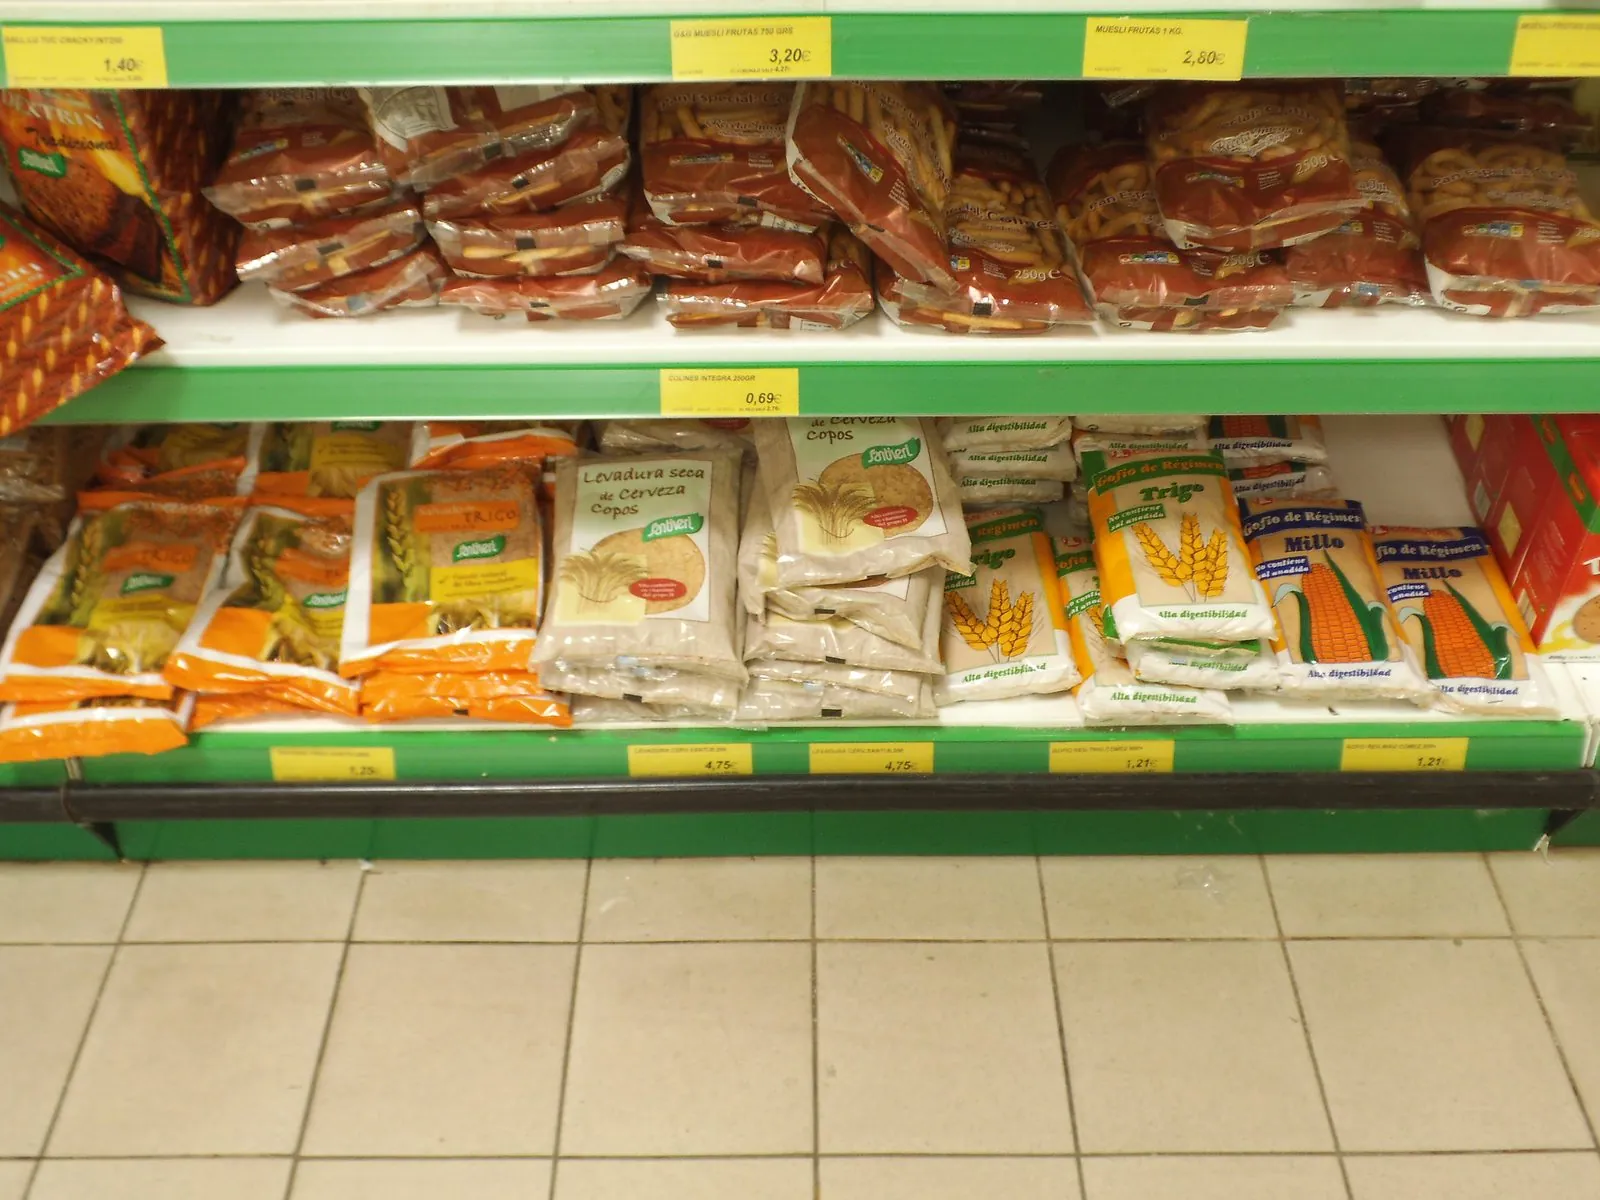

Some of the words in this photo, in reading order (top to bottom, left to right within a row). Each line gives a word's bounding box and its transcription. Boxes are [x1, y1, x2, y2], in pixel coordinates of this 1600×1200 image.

[693, 28, 725, 37] MUESLI
[726, 27, 758, 36] FRUTAS
[1095, 25, 1126, 34] MUESLI
[1127, 26, 1161, 35] FRUTAS
[1294, 155, 1329, 176] 250g
[1221, 255, 1255, 268] 250g
[1013, 269, 1047, 281] 250g
[701, 374, 732, 382] INTEGRA
[966, 425, 985, 434] Alta
[986, 421, 1048, 433] digestibilidad
[1107, 442, 1127, 450] Alta
[988, 454, 1049, 463] digestibilidad
[583, 467, 664, 484] Levadura
[668, 468, 706, 479] seca
[1096, 467, 1138, 488] Gofio
[1141, 463, 1159, 474] de
[599, 491, 615, 501] de
[618, 484, 686, 500] Cerveza
[1139, 482, 1205, 504] Trigo
[462, 509, 517, 523] TRIGO
[1121, 504, 1162, 519] contiene
[1110, 522, 1124, 532] sal
[1243, 514, 1281, 537] Gofio
[1283, 511, 1302, 522] de
[1283, 533, 1345, 553] Millo
[1400, 544, 1417, 556] de
[1419, 542, 1482, 558] Régimen
[1267, 557, 1307, 569] contiene
[1402, 566, 1464, 580] Millo
[1179, 608, 1248, 620] digestibilidad
[1109, 691, 1131, 701] Alta
[1132, 691, 1198, 704] digestibilidad
